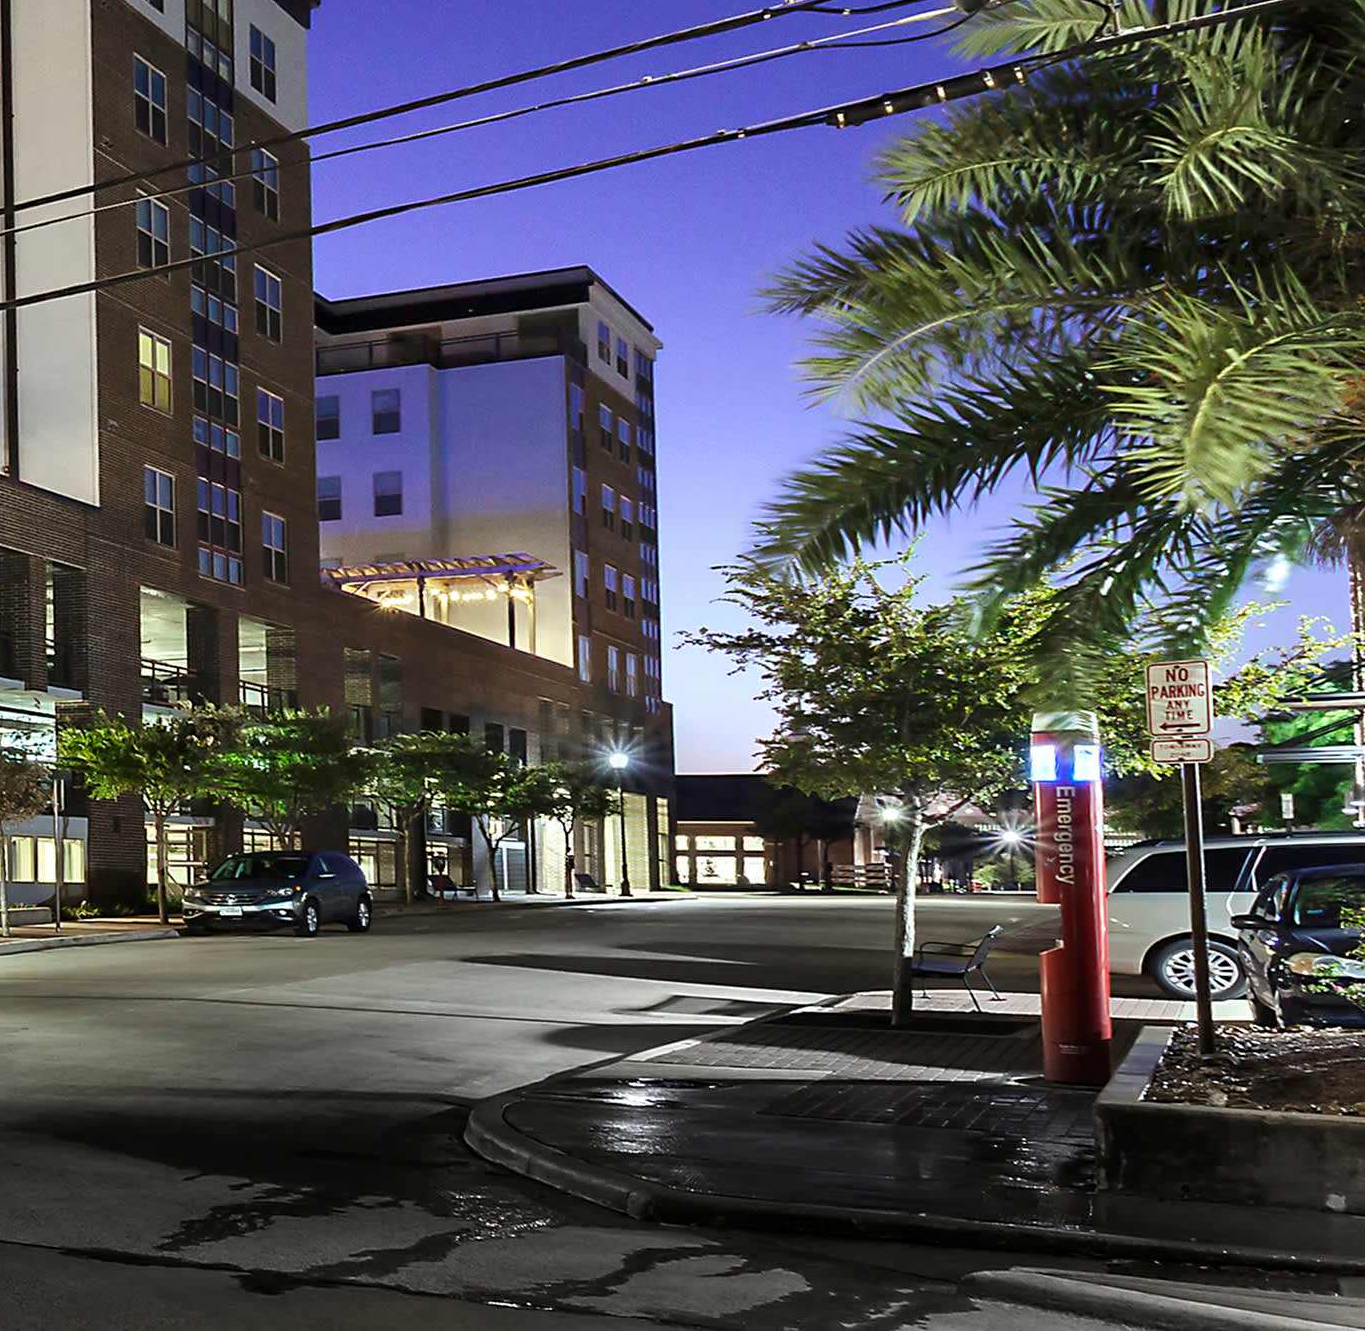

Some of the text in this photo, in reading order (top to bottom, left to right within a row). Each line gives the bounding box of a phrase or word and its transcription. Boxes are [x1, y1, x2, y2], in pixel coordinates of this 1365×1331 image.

[1165, 668, 1189, 682] NO
[1151, 683, 1206, 699] PARKING
[1166, 700, 1190, 710] ANY
[1165, 710, 1193, 720] TIME
[1054, 786, 1075, 885] Emergency
